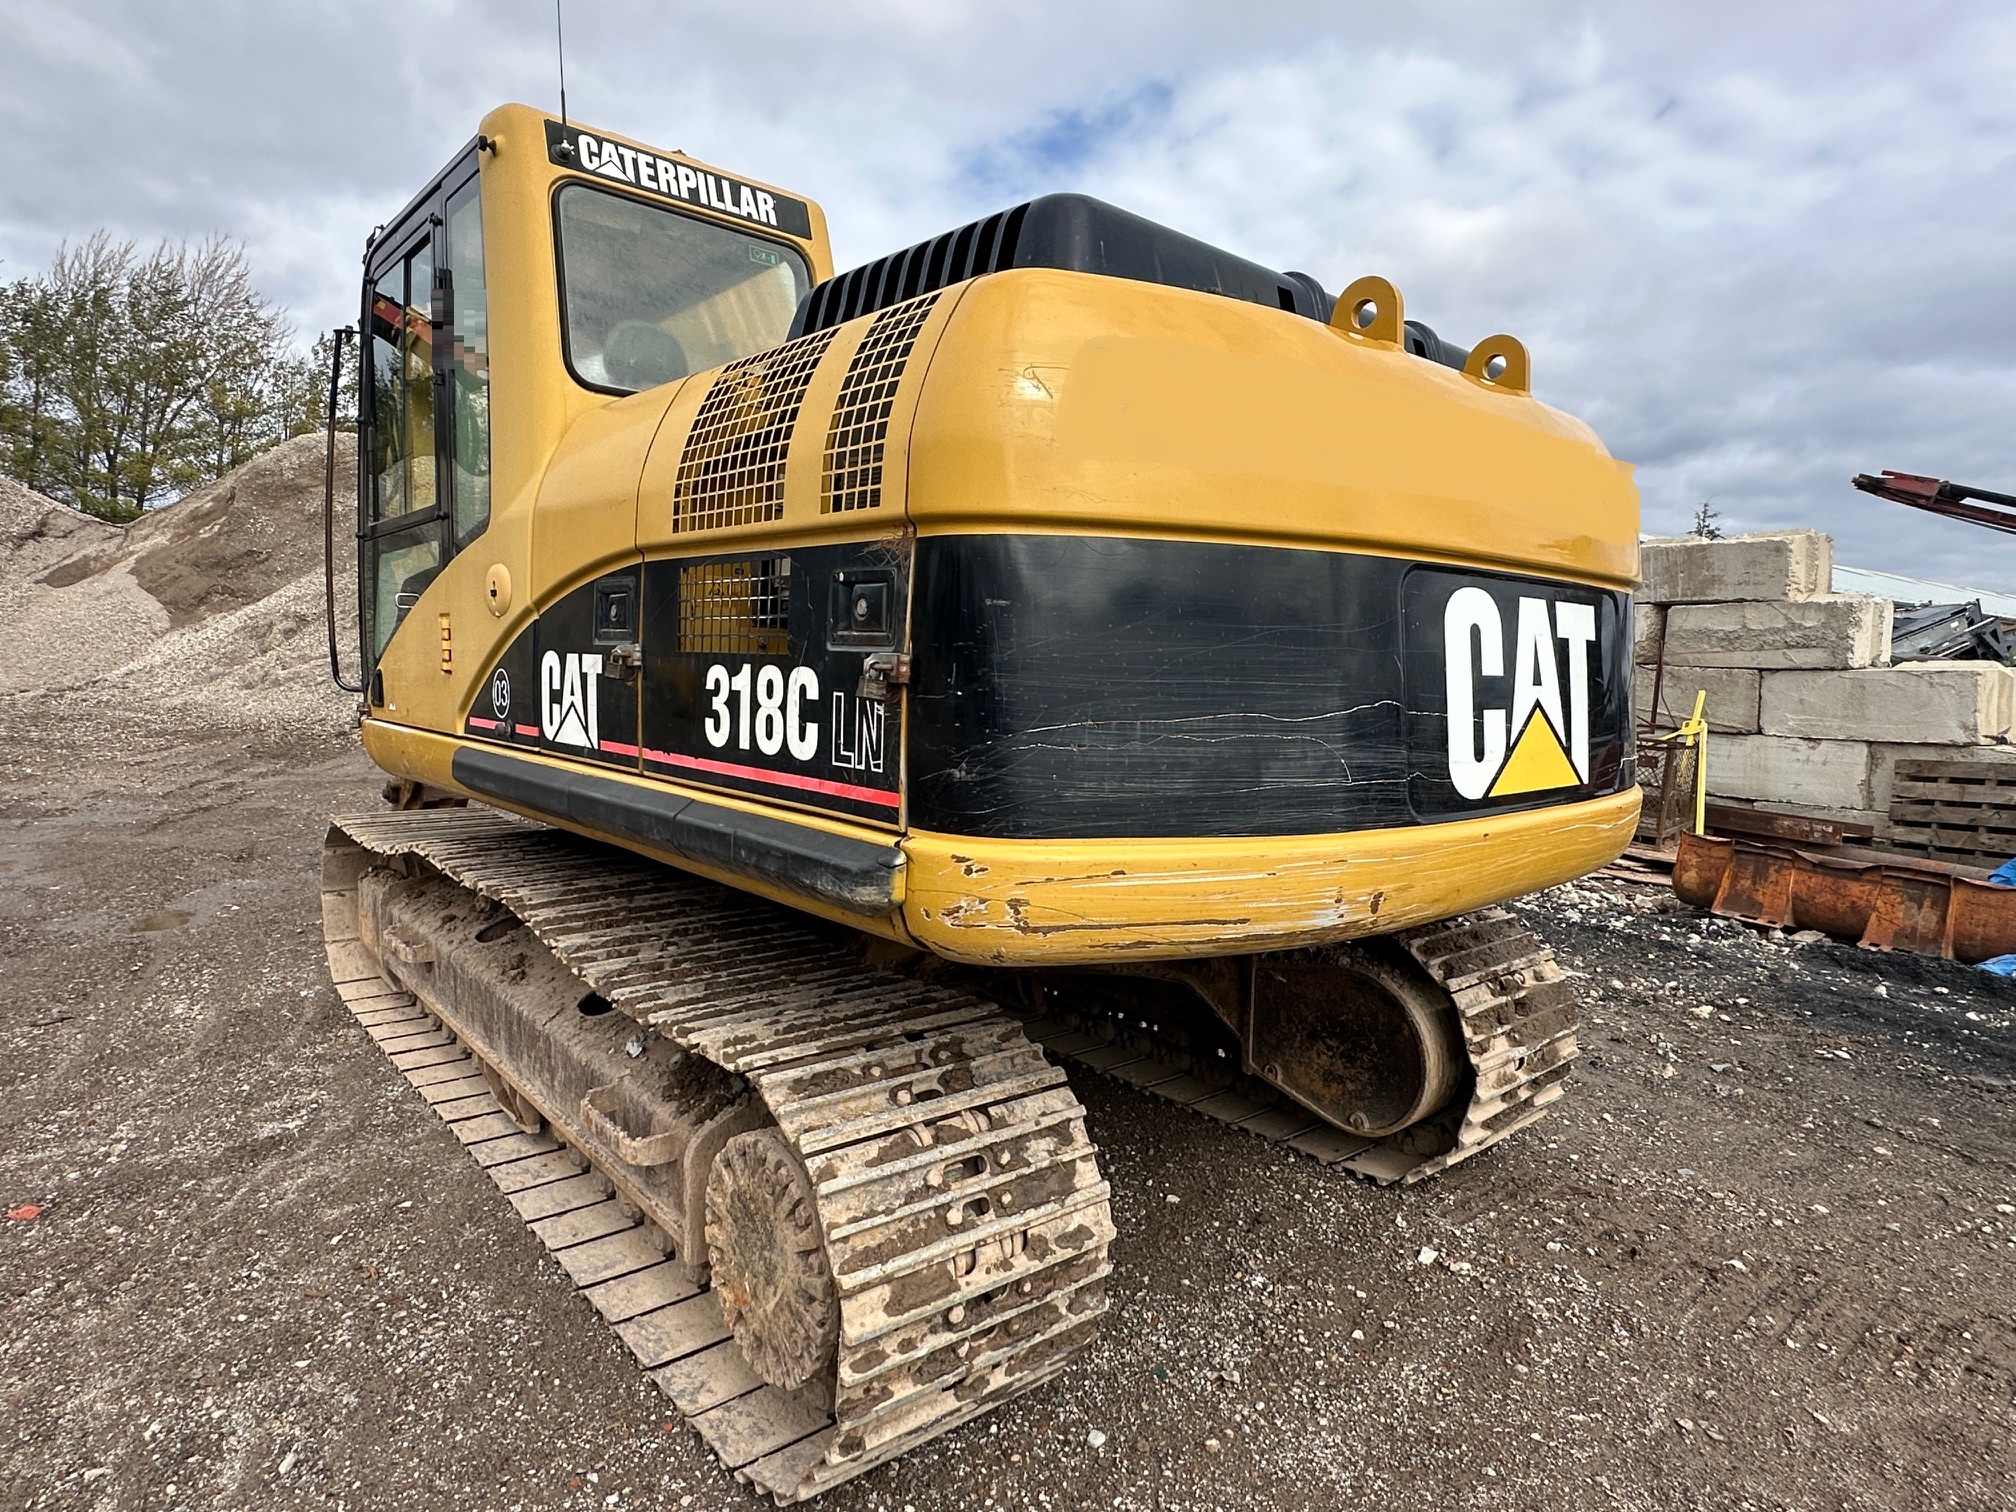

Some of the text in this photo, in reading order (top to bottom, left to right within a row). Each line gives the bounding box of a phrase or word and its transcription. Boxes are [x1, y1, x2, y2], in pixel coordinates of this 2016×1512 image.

[577, 133, 778, 227] CATERPILLAR
[494, 680, 508, 707] 03
[541, 650, 603, 750] CAT
[704, 663, 885, 774] 318C LN
[1443, 586, 1597, 801] CAT
